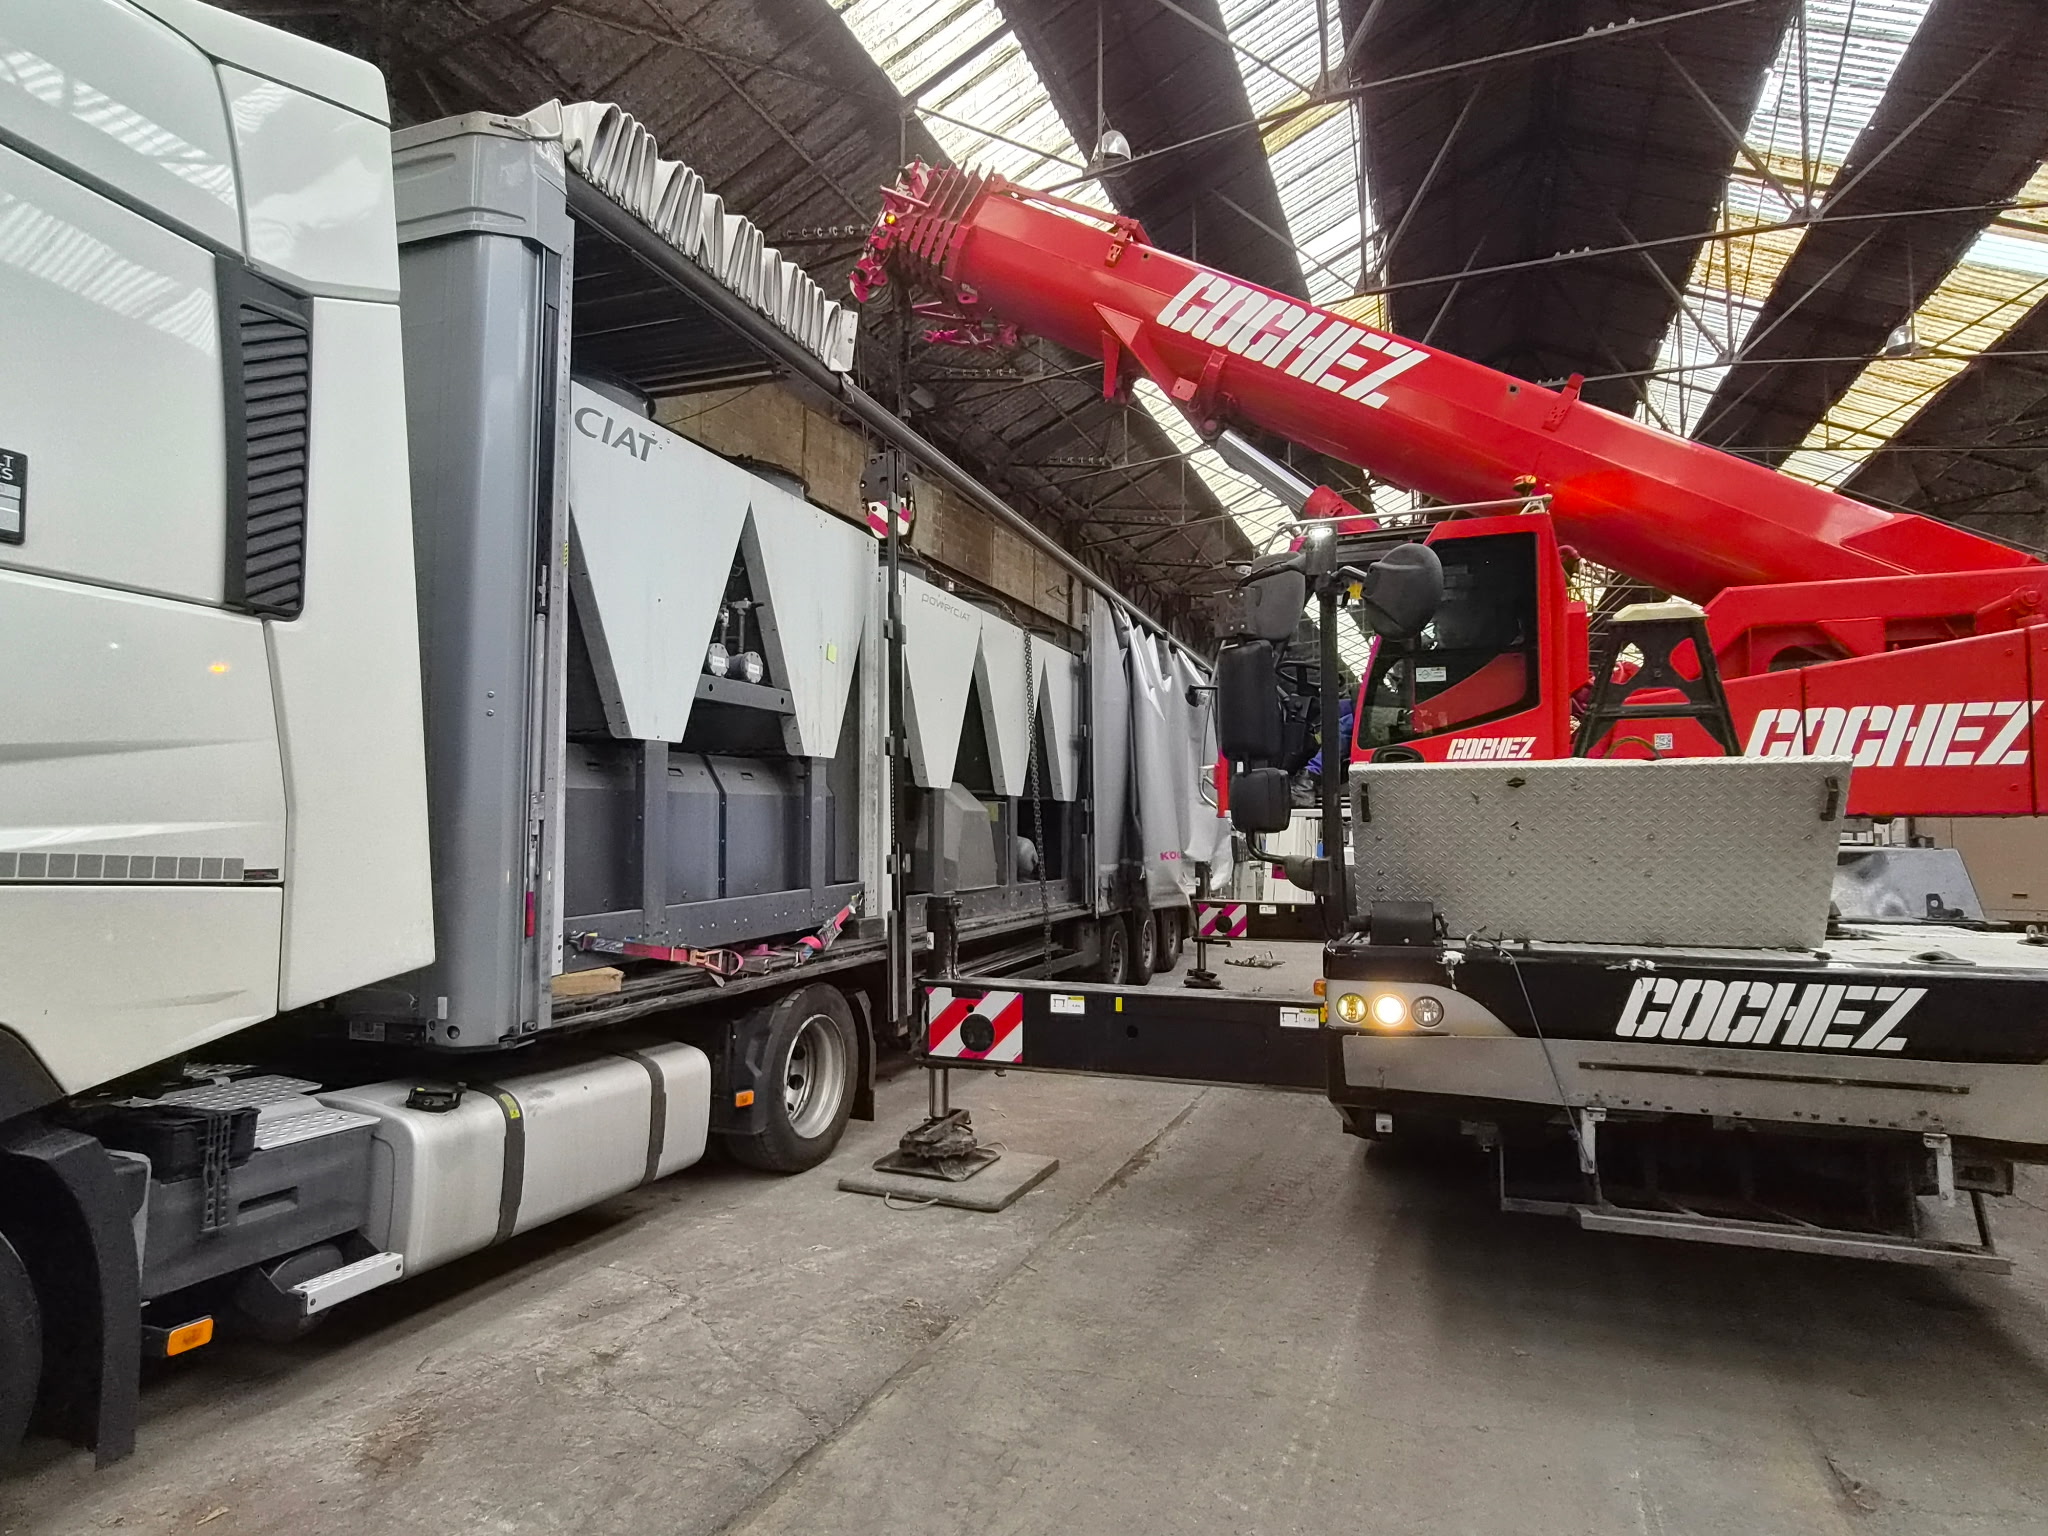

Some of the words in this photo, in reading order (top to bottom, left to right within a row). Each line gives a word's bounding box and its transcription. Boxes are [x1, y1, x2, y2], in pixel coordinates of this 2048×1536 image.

[1156, 272, 1431, 409] COCHEZ
[575, 407, 658, 462] CIAT
[1446, 737, 1537, 760] COCHEZ
[1743, 700, 2045, 767] COCHEZ
[1615, 977, 1929, 1050] COCHEZ
